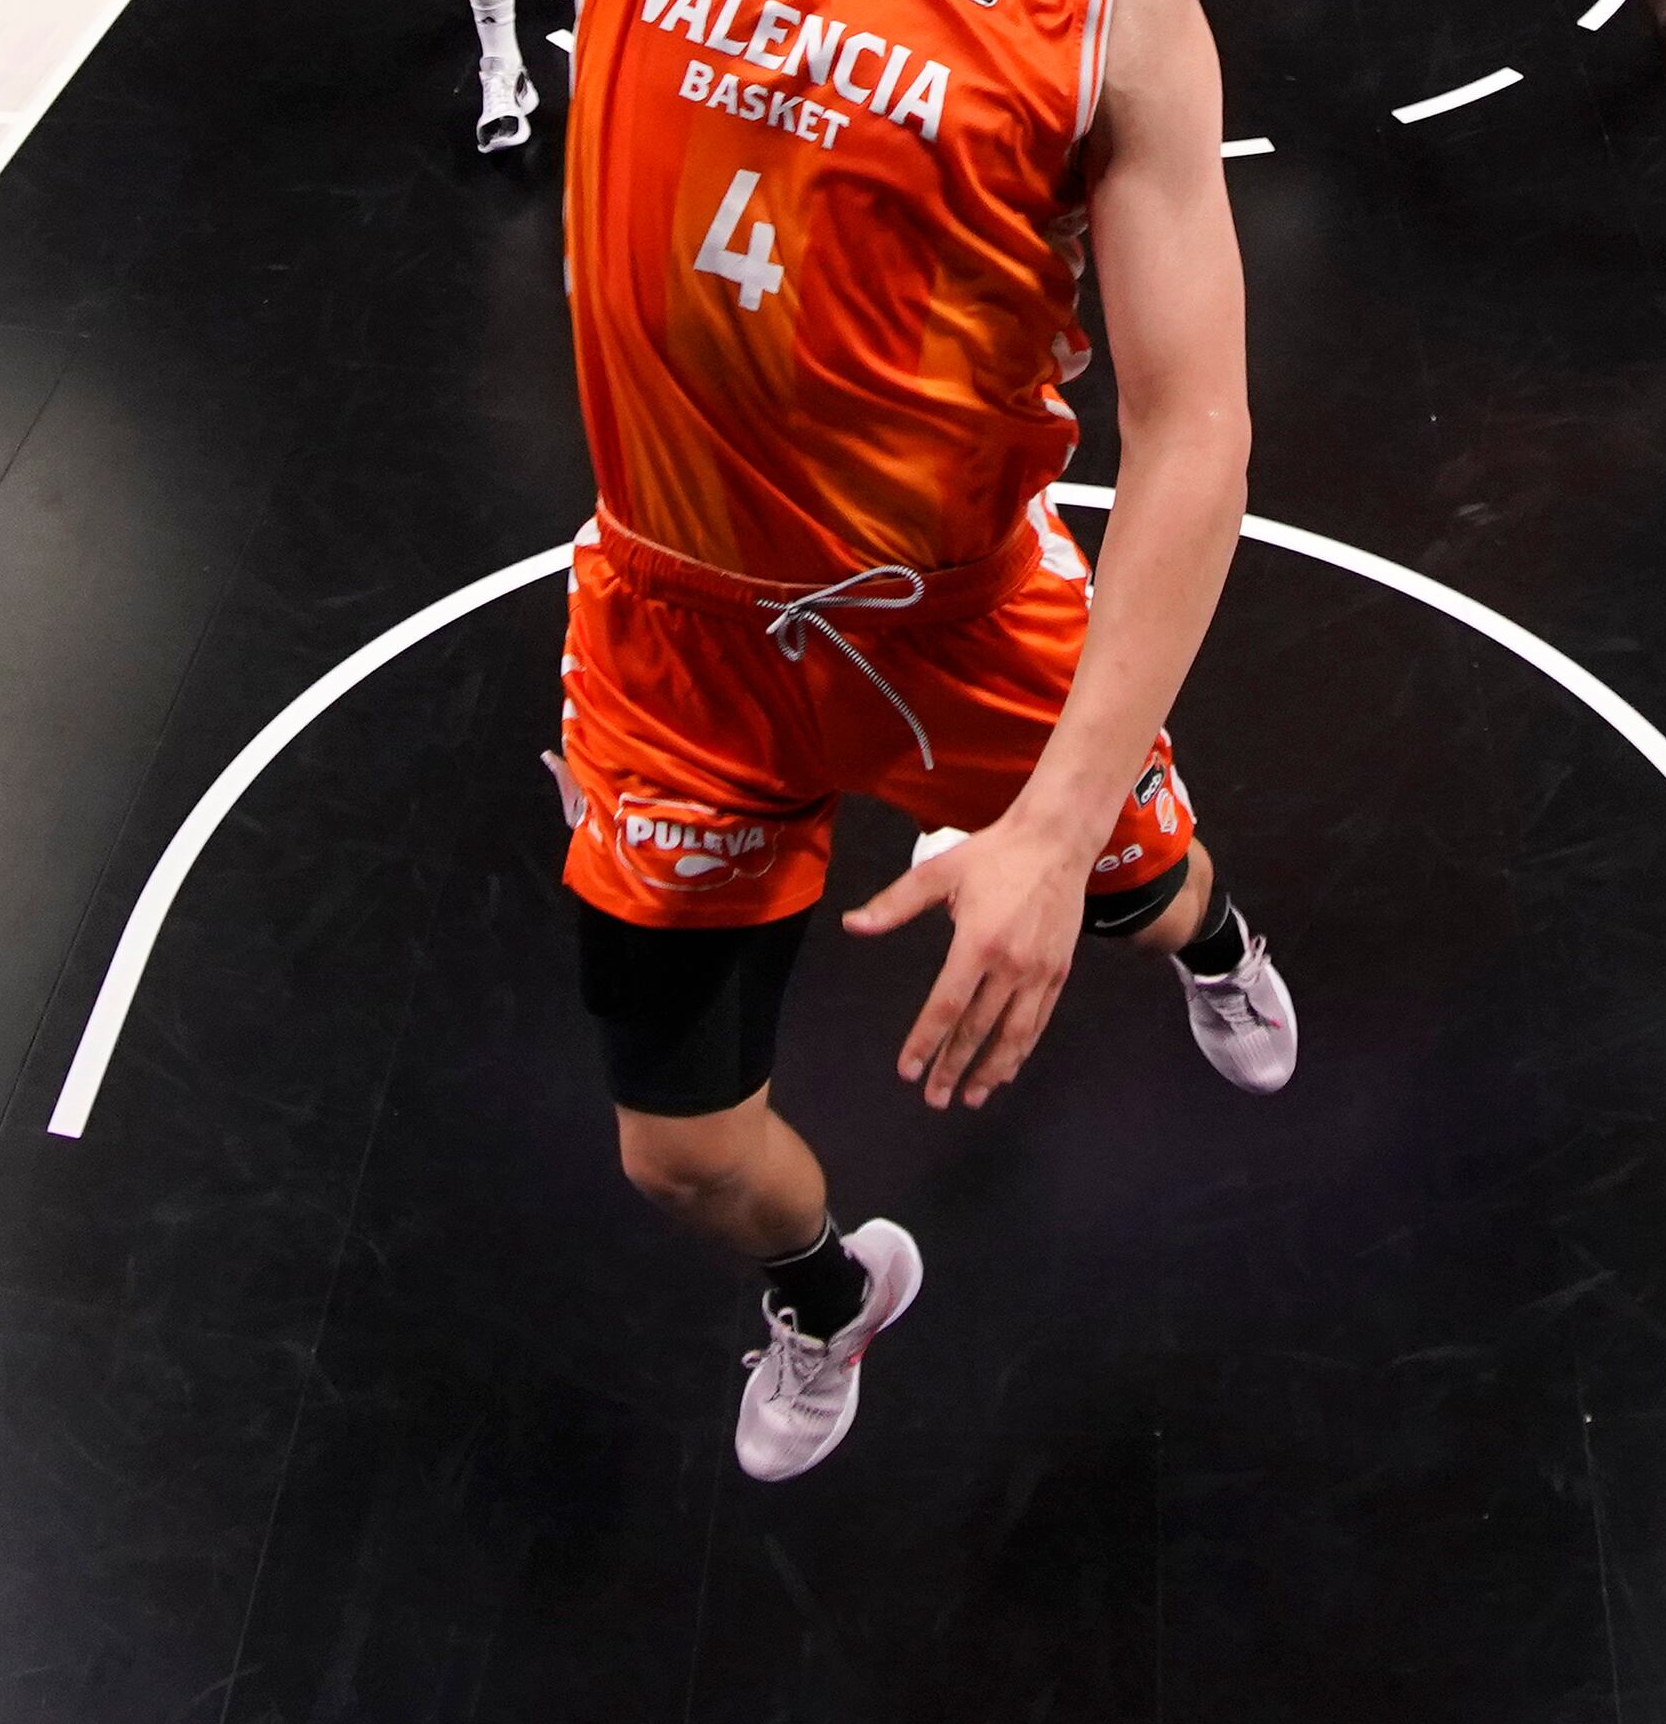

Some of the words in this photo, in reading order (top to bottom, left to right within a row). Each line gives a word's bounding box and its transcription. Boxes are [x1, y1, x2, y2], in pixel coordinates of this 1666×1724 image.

[679, 59, 850, 149] BASKET
[694, 168, 785, 312] 4
[626, 815, 767, 857] PULEVA
